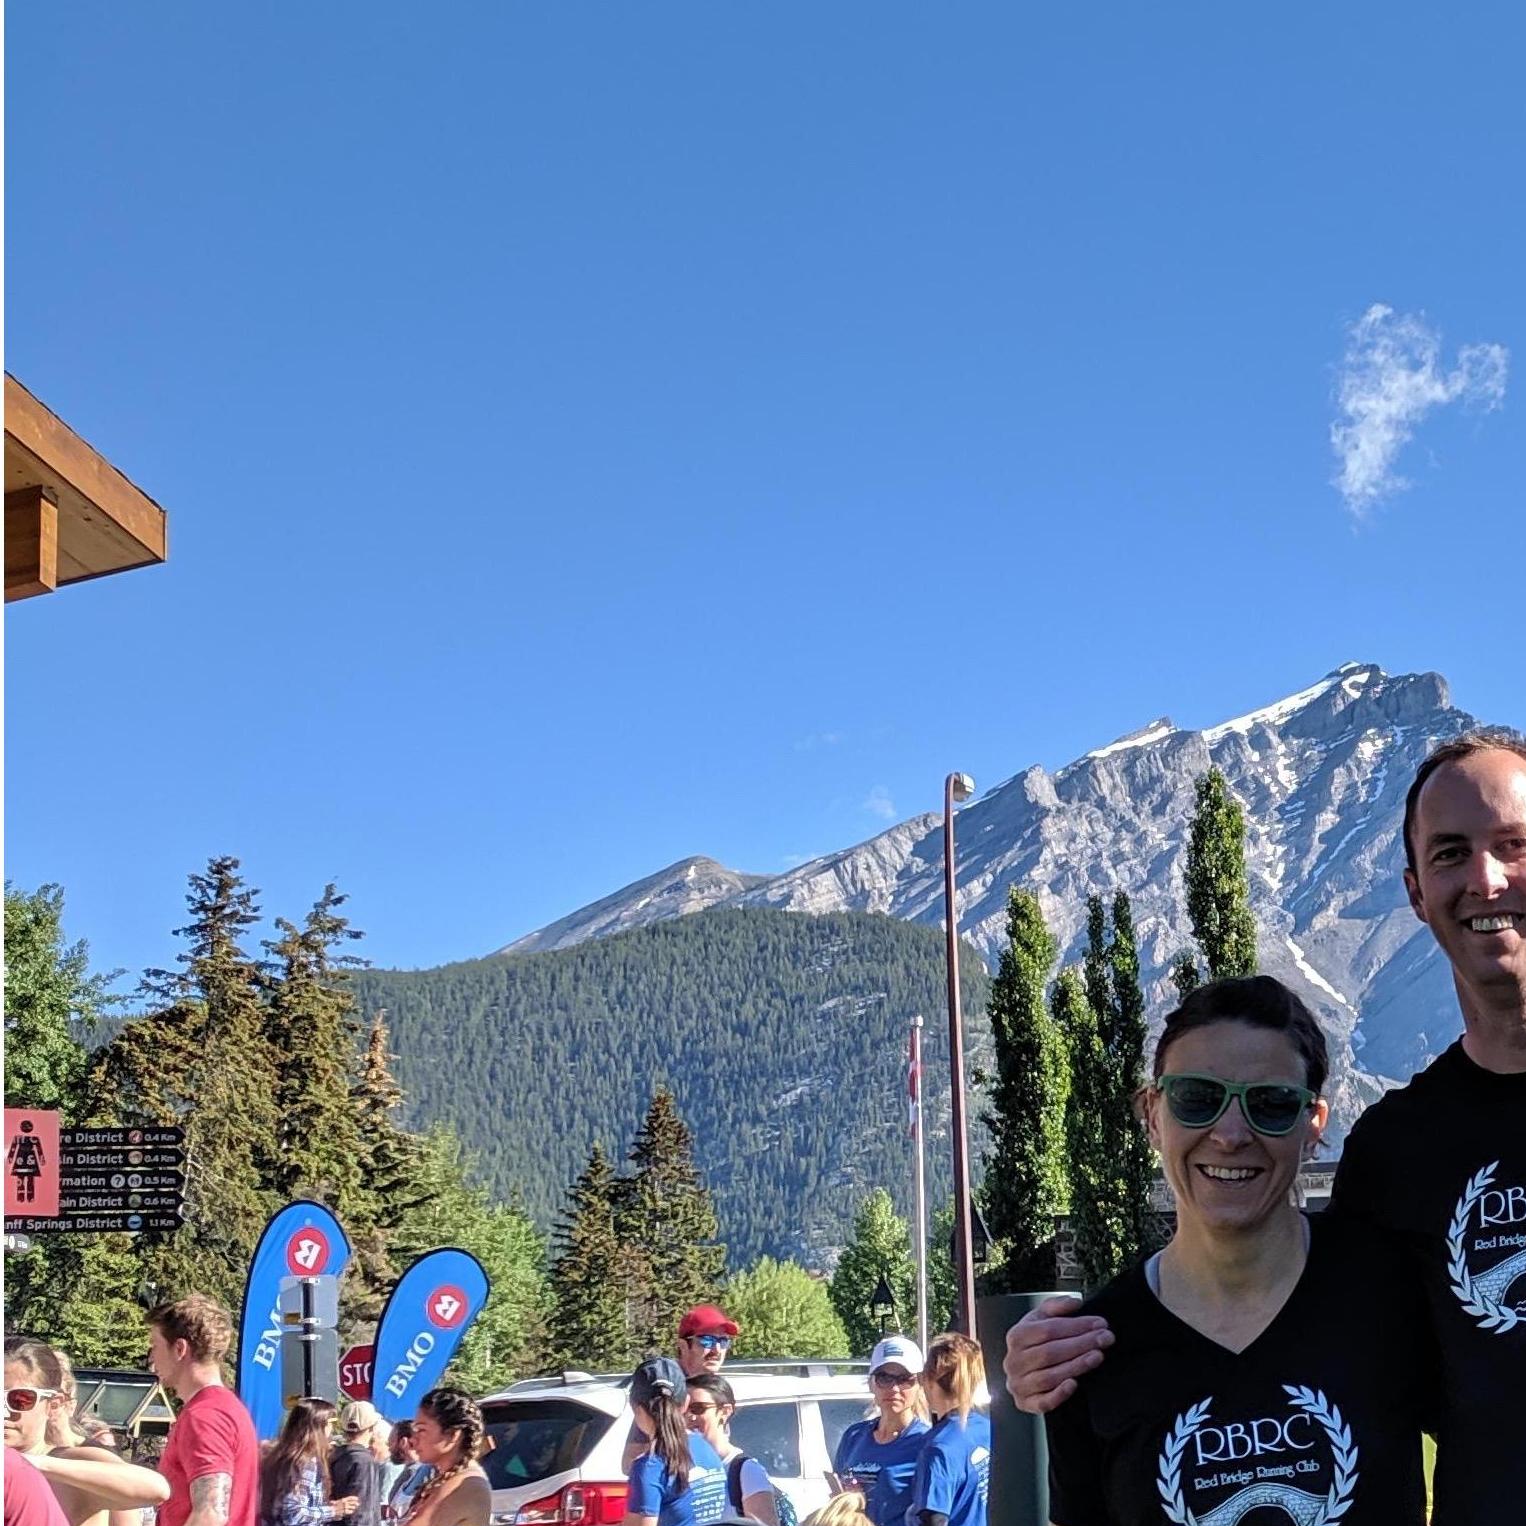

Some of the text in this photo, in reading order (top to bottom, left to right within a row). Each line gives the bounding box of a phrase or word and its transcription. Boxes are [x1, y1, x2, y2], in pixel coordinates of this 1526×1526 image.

[75, 1132, 124, 1143] District
[161, 1134, 176, 1142] Km
[77, 1153, 124, 1164] District
[161, 1155, 176, 1163] Km
[144, 1177, 159, 1185] 0.5
[161, 1177, 176, 1185] Km
[79, 1196, 123, 1208] District
[161, 1197, 176, 1206] Km
[6, 1219, 23, 1229] nff
[27, 1218, 73, 1231] Springs
[76, 1217, 123, 1229] District
[160, 1219, 175, 1227] Km
[1474, 1236, 1497, 1250] Red
[252, 1296, 283, 1372] BM
[384, 1331, 436, 1400] BMO
[342, 1363, 371, 1386] STO
[1194, 1412, 1315, 1466] RBRC
[1194, 1458, 1320, 1490] Red Bridge Running Club
